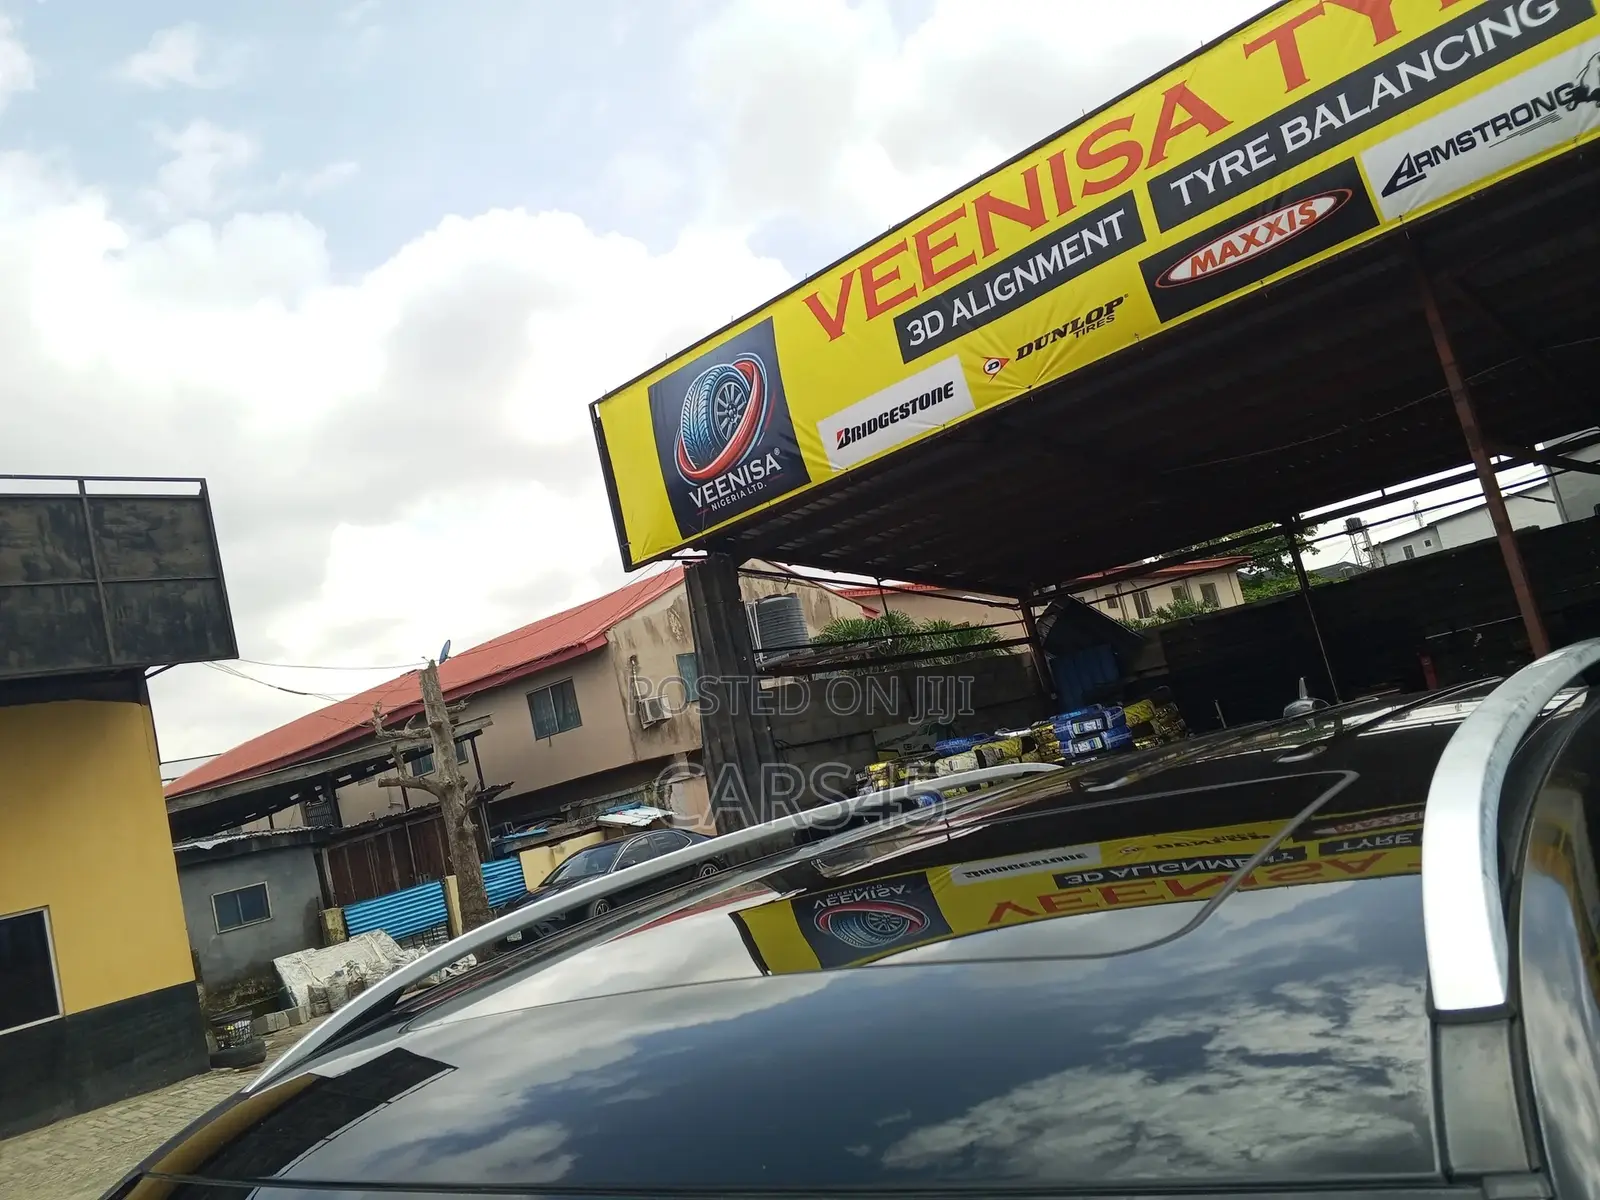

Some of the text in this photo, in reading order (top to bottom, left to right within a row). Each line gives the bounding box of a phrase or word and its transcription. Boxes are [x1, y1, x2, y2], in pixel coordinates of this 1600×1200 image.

[1169, 0, 1560, 207] TYRE BALANCING
[1381, 82, 1577, 198] ARMSTRONG
[803, 0, 1468, 342] VEENISA TY
[905, 208, 1126, 347] 3D ALIGNMENT
[1189, 200, 1318, 278] MAXXIS
[1073, 314, 1116, 339] TIRES
[835, 380, 954, 451] BRIDGESTONE
[710, 481, 767, 512] NIGERIA LTD.
